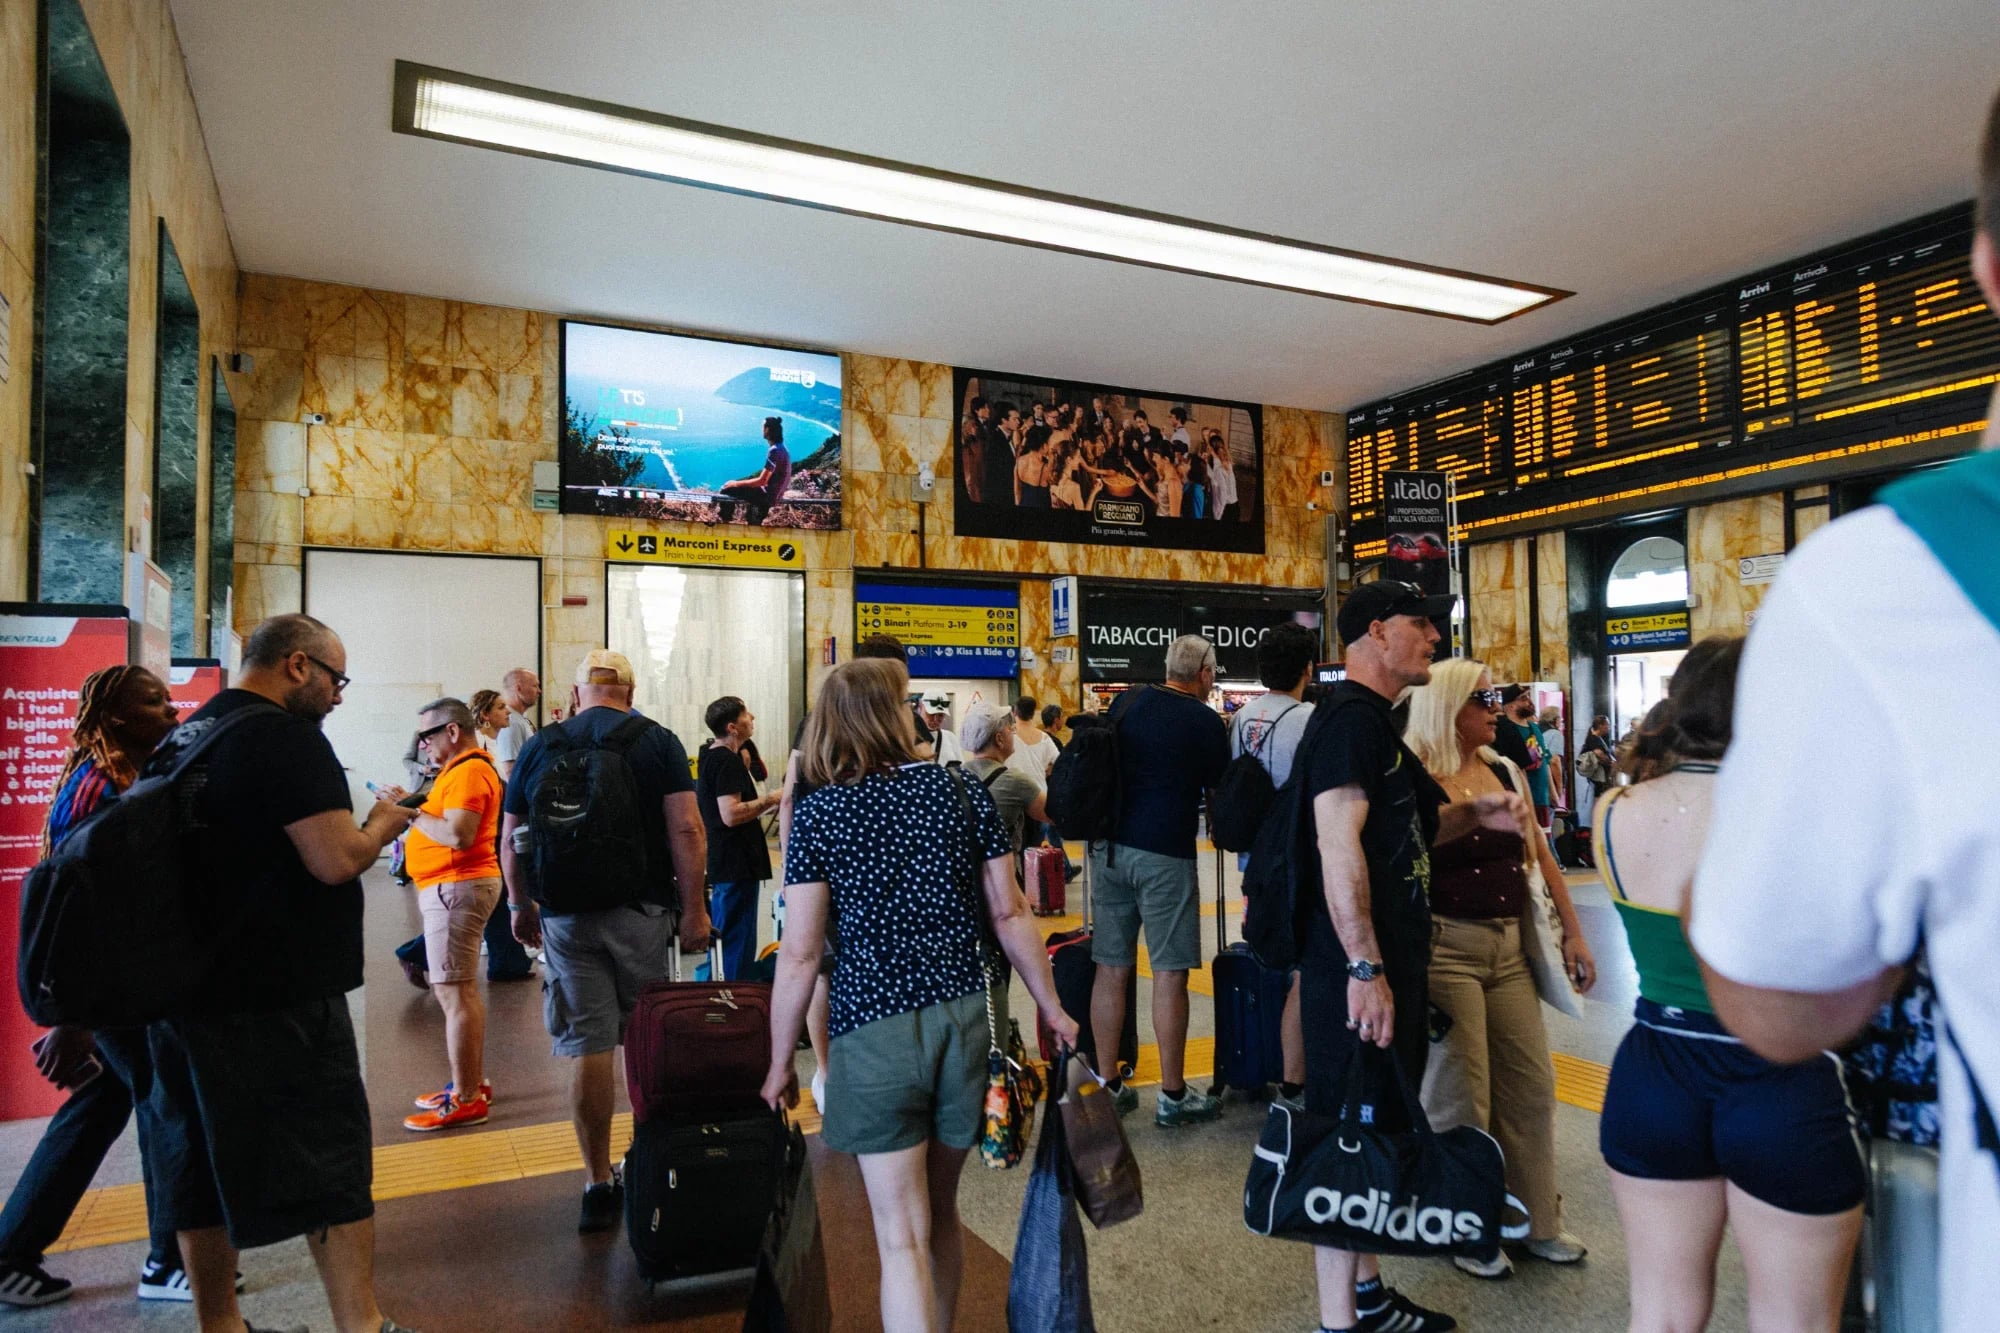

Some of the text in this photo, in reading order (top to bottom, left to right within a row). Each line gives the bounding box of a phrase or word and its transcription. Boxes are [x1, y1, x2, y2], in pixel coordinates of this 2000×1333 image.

[1739, 264, 1828, 300] Arrivi Arrivals
[1513, 358, 1534, 373] Arrivi
[1098, 503, 1140, 513] PARMIGIANO
[1102, 511, 1136, 521] REGGIANO
[664, 536, 772, 554] Marconi Express
[664, 550, 726, 562] Train to airport
[884, 618, 967, 629] Binari Platforms 3-19
[1087, 625, 1177, 646] TABACCHI
[956, 647, 1003, 656] Kiss & Ride
[3, 687, 80, 702] Acquista
[18, 702, 64, 714] i tuoi
[6, 716, 76, 732] biglietti
[24, 731, 58, 744] alle
[0, 746, 21, 760] elf
[6, 761, 65, 775] è sicur
[8, 777, 19, 789] è
[1, 792, 12, 805] è
[1304, 1186, 1485, 1245] adidas
